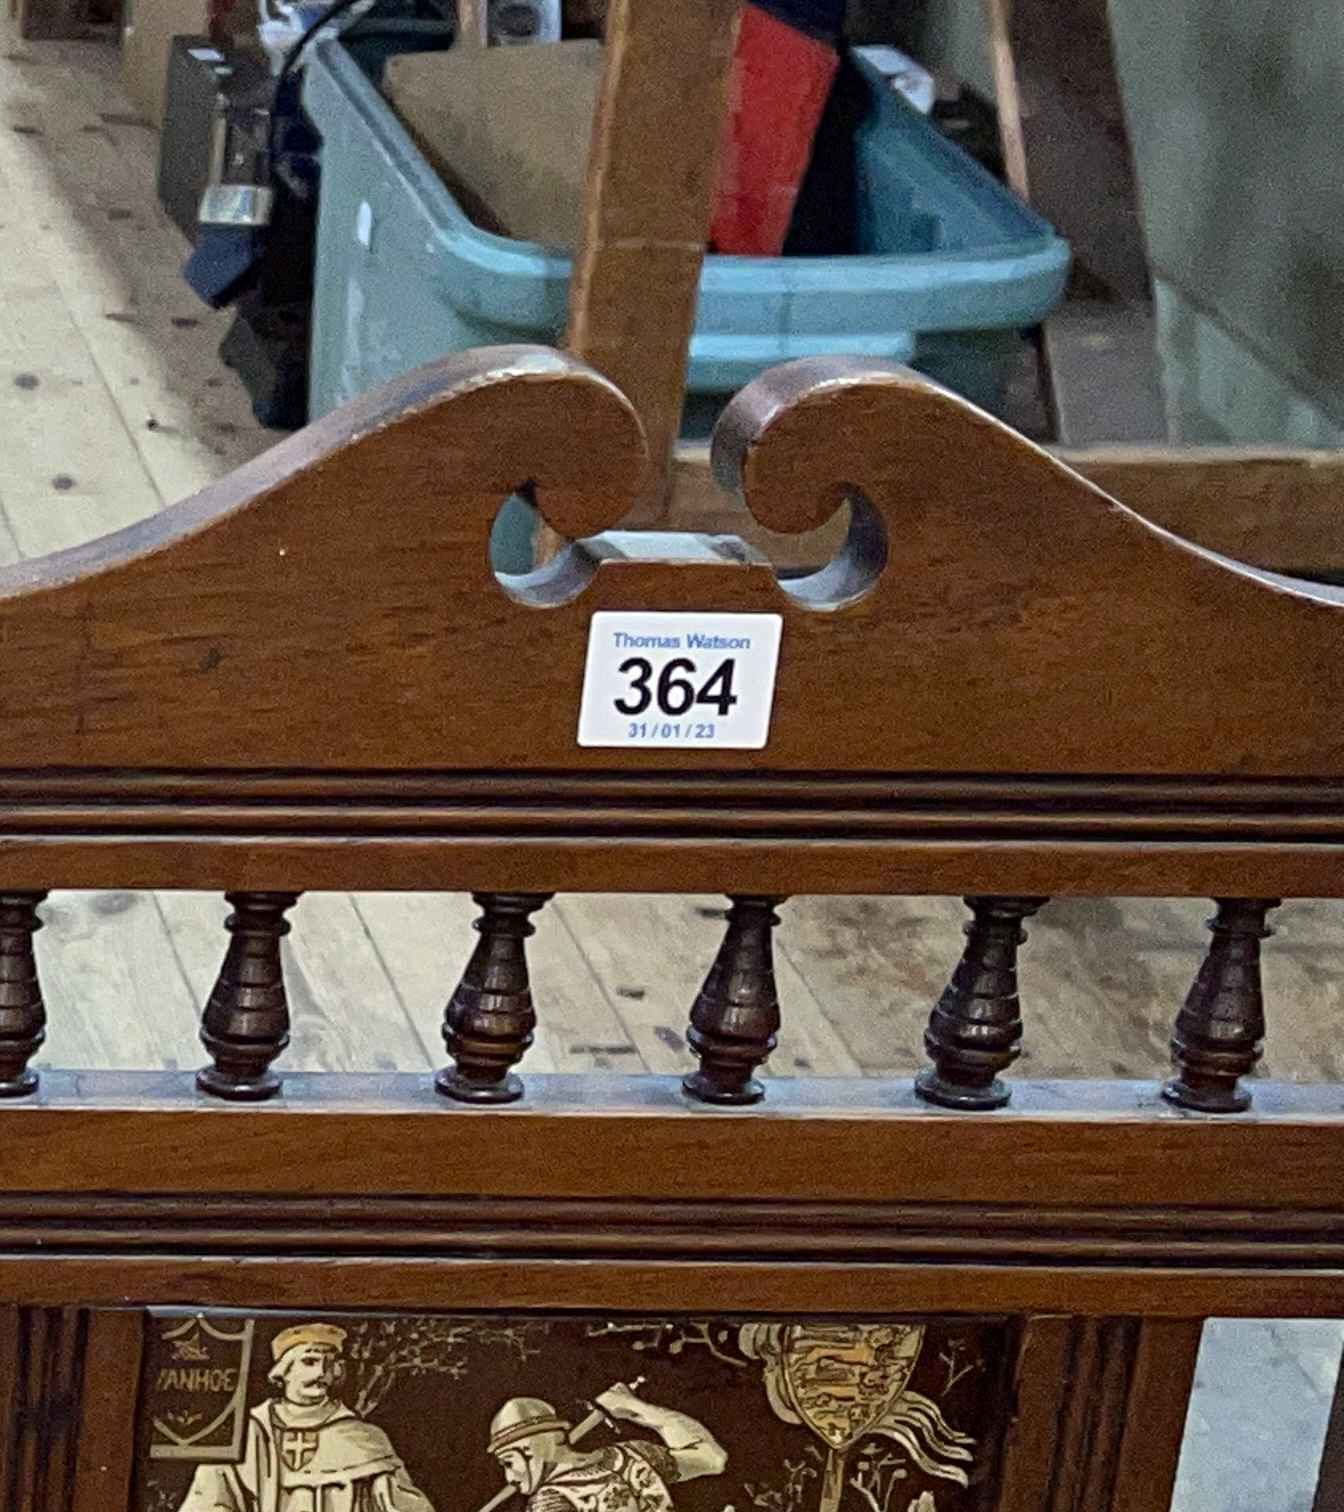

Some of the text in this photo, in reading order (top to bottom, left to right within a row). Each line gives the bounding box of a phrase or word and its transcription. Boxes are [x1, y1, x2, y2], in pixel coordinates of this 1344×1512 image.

[613, 632, 751, 649] Thomas Watson
[613, 656, 738, 716] 364
